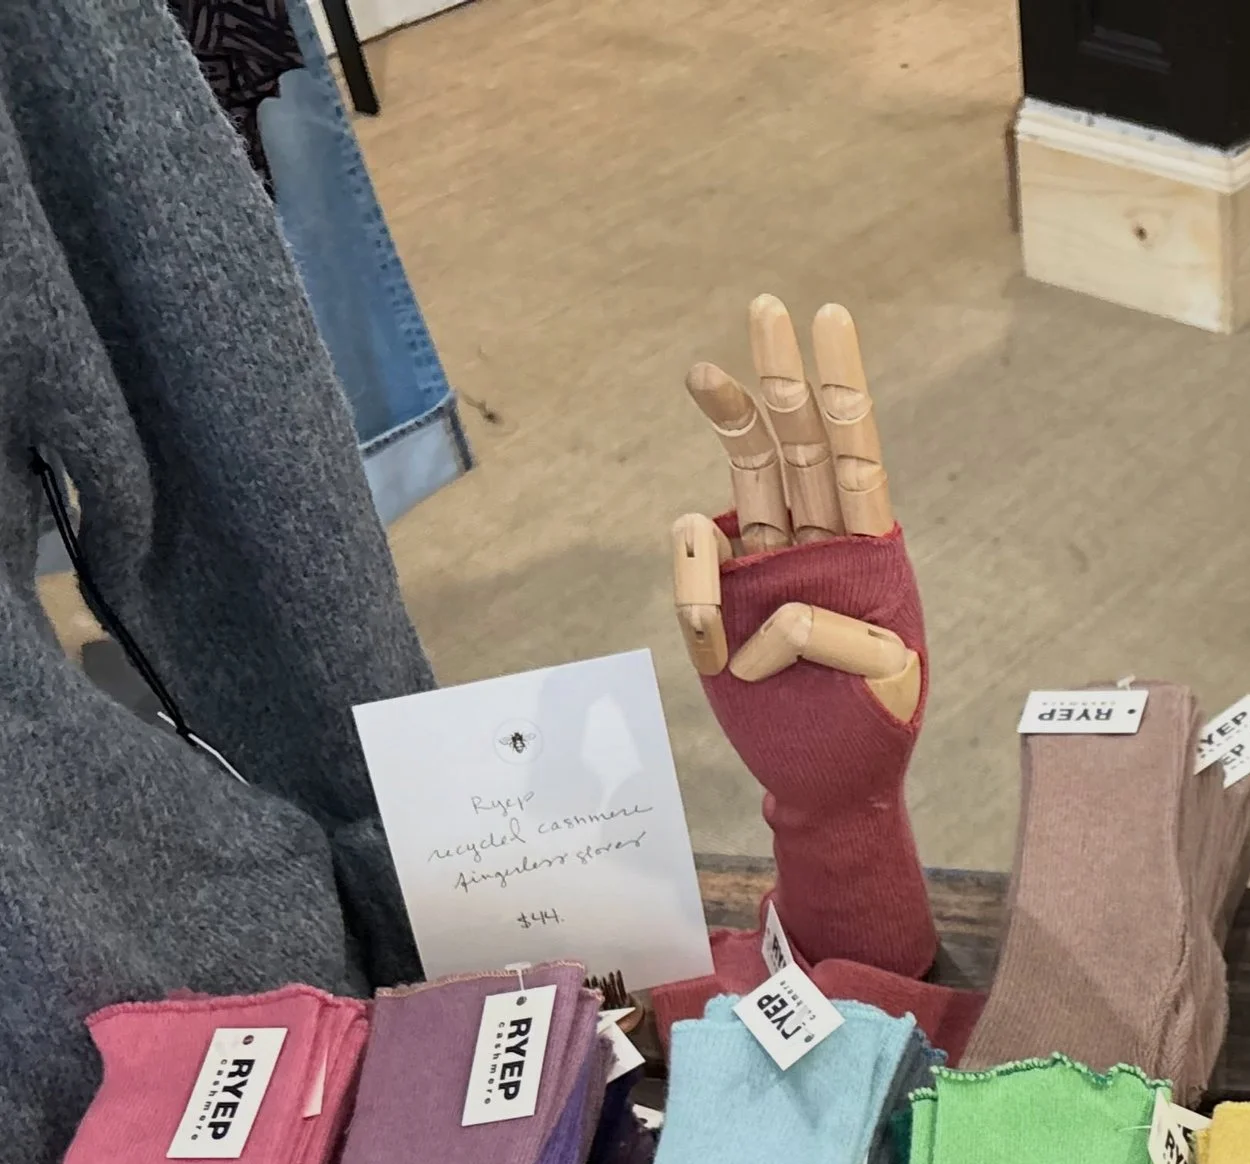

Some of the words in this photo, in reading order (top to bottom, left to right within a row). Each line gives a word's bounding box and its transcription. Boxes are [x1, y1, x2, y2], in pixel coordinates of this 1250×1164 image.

[1037, 707, 1115, 721] RYEP
[427, 819, 527, 863] recycled
[538, 803, 654, 836] cashmere
[471, 791, 536, 816] Ryep
[454, 851, 569, 894] fingerless
[575, 831, 648, 866] gloves
[484, 1021, 506, 1105] cashmere
[498, 1017, 533, 1101] RYEP
[191, 1059, 228, 1141] cashmere
[207, 1059, 256, 1140] RYEP
